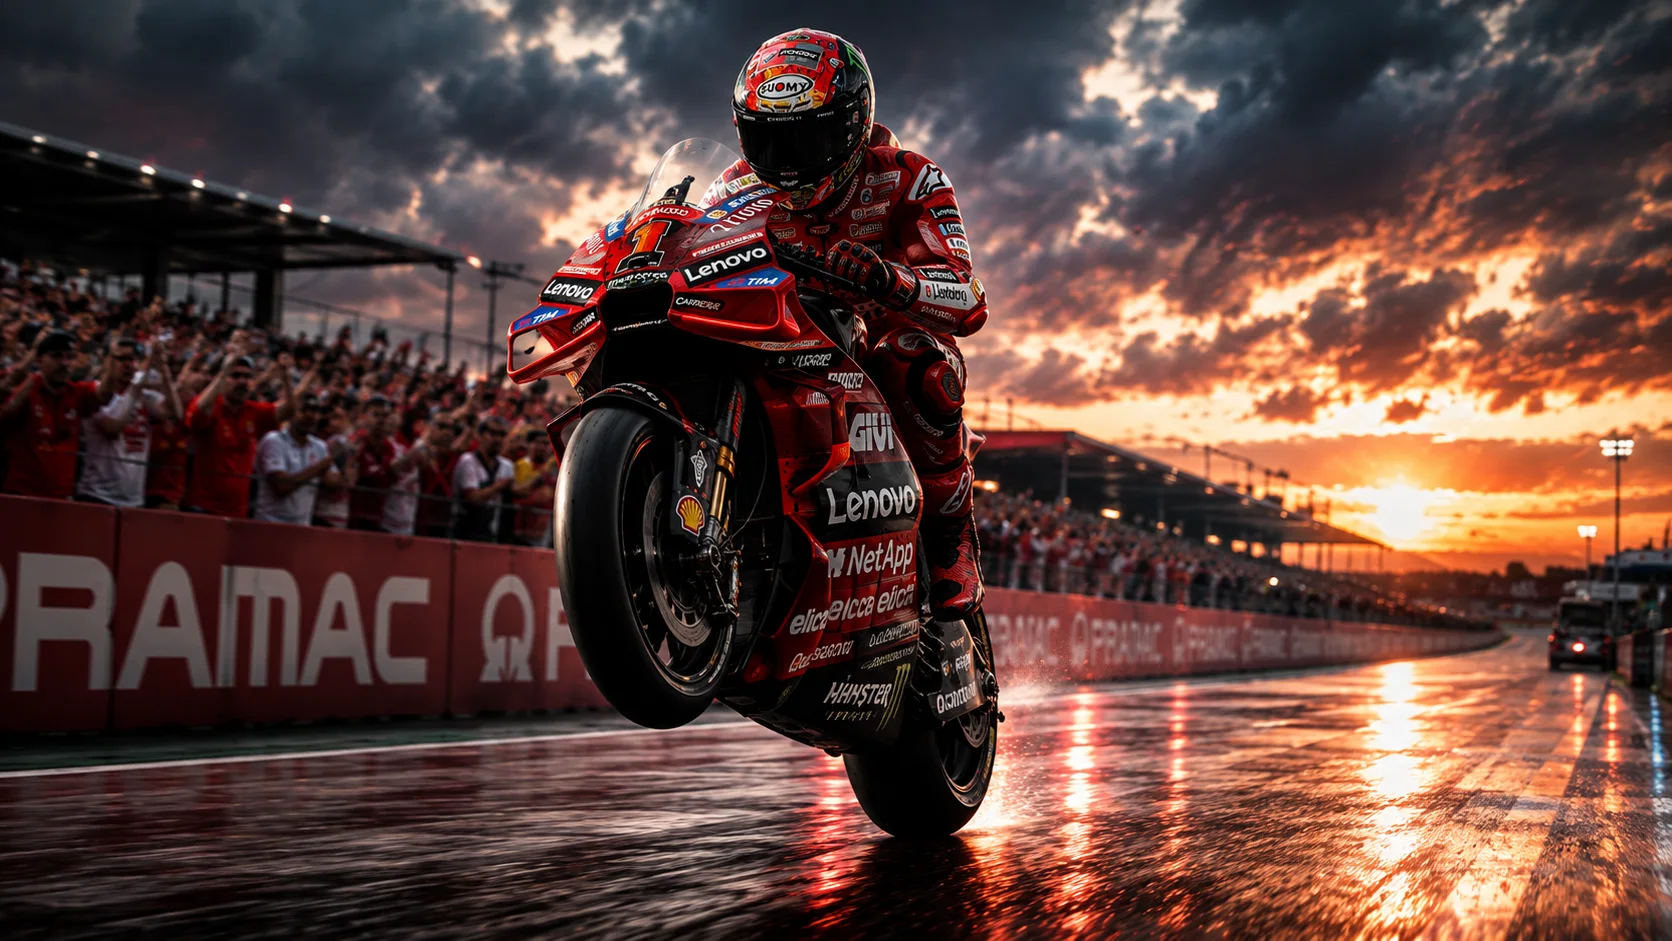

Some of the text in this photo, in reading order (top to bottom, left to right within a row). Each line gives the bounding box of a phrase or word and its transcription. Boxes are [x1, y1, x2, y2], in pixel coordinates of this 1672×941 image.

[760, 82, 808, 94] SUOMY
[614, 218, 672, 274] 1
[684, 247, 767, 282] Lenovo
[747, 277, 778, 285] TIM
[543, 279, 594, 299] Lenovo
[532, 310, 559, 324] TIM
[850, 413, 894, 452] GIVI
[826, 485, 916, 525] Lenovo
[846, 539, 914, 576] NetApp
[0, 552, 430, 691] RAMAC
